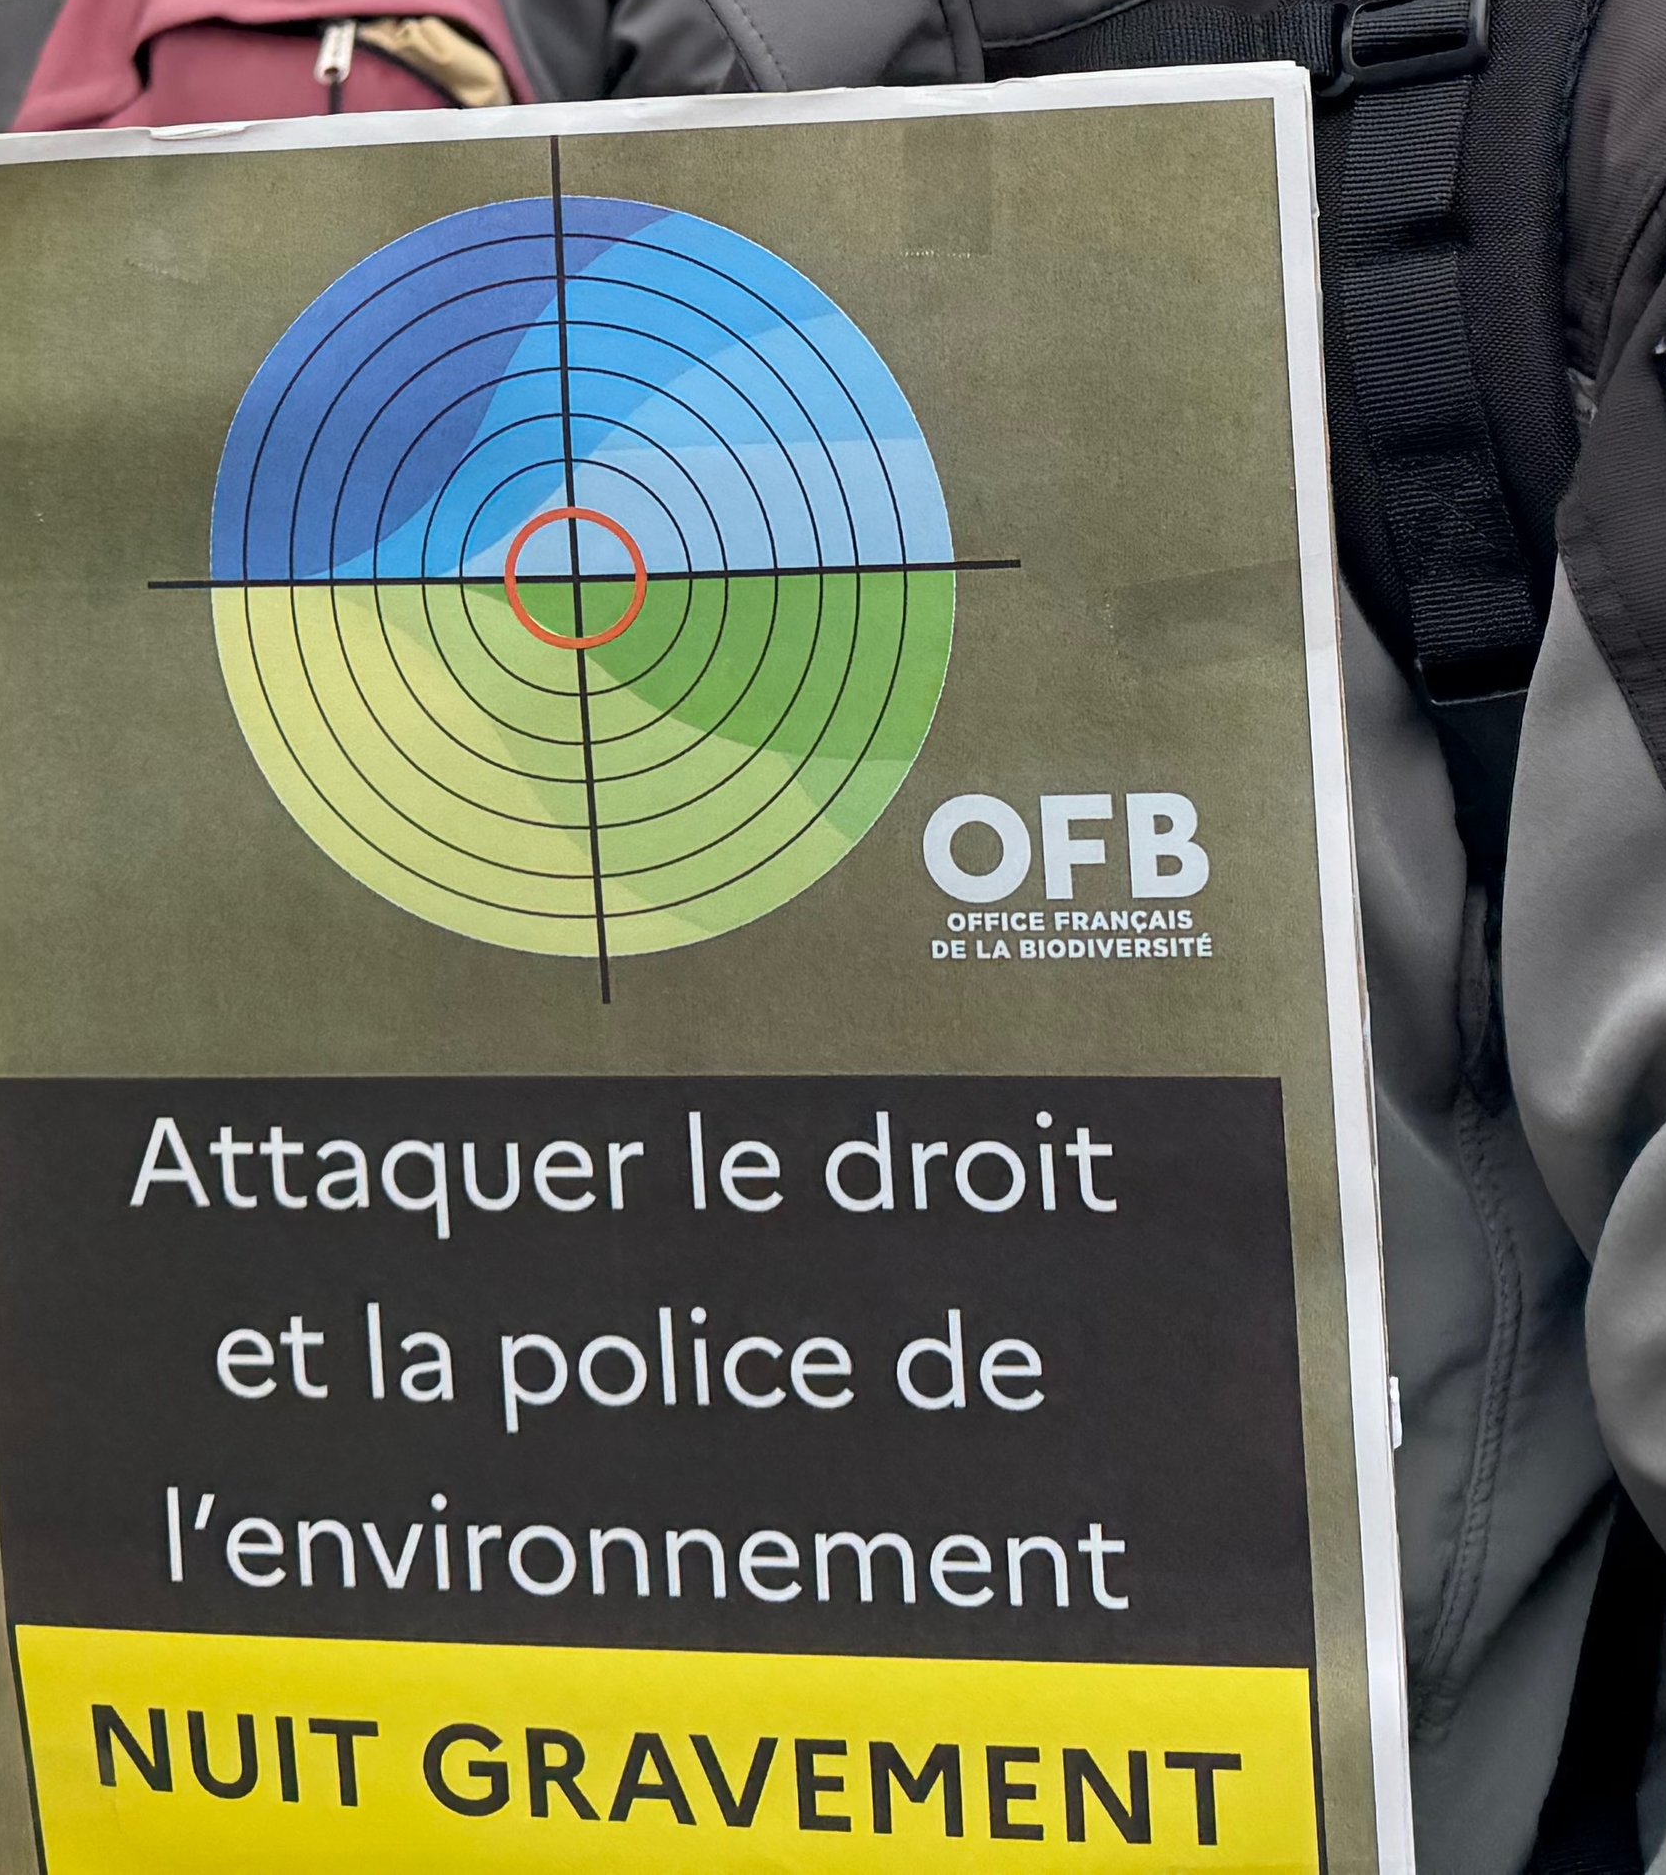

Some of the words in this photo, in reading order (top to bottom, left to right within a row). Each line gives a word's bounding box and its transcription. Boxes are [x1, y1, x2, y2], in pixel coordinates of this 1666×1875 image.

[922, 792, 1210, 904] OFB
[931, 939, 968, 960] DE
[976, 939, 1012, 960] LA
[1019, 932, 1213, 959] BIODIVERSITÉ
[947, 911, 1046, 933] OFFICE
[1053, 909, 1194, 934] FRANÇAIS
[130, 1117, 644, 1240] Attaquer
[688, 1111, 784, 1212] le
[825, 1110, 1118, 1213] droit
[216, 1315, 328, 1400] et
[367, 1302, 454, 1402] la
[501, 1306, 855, 1433] police
[896, 1308, 1045, 1412] de
[166, 1486, 1129, 1611] l'environnement
[91, 1703, 379, 1808] NUIT
[422, 1723, 1242, 1847] GRAVEMENT
